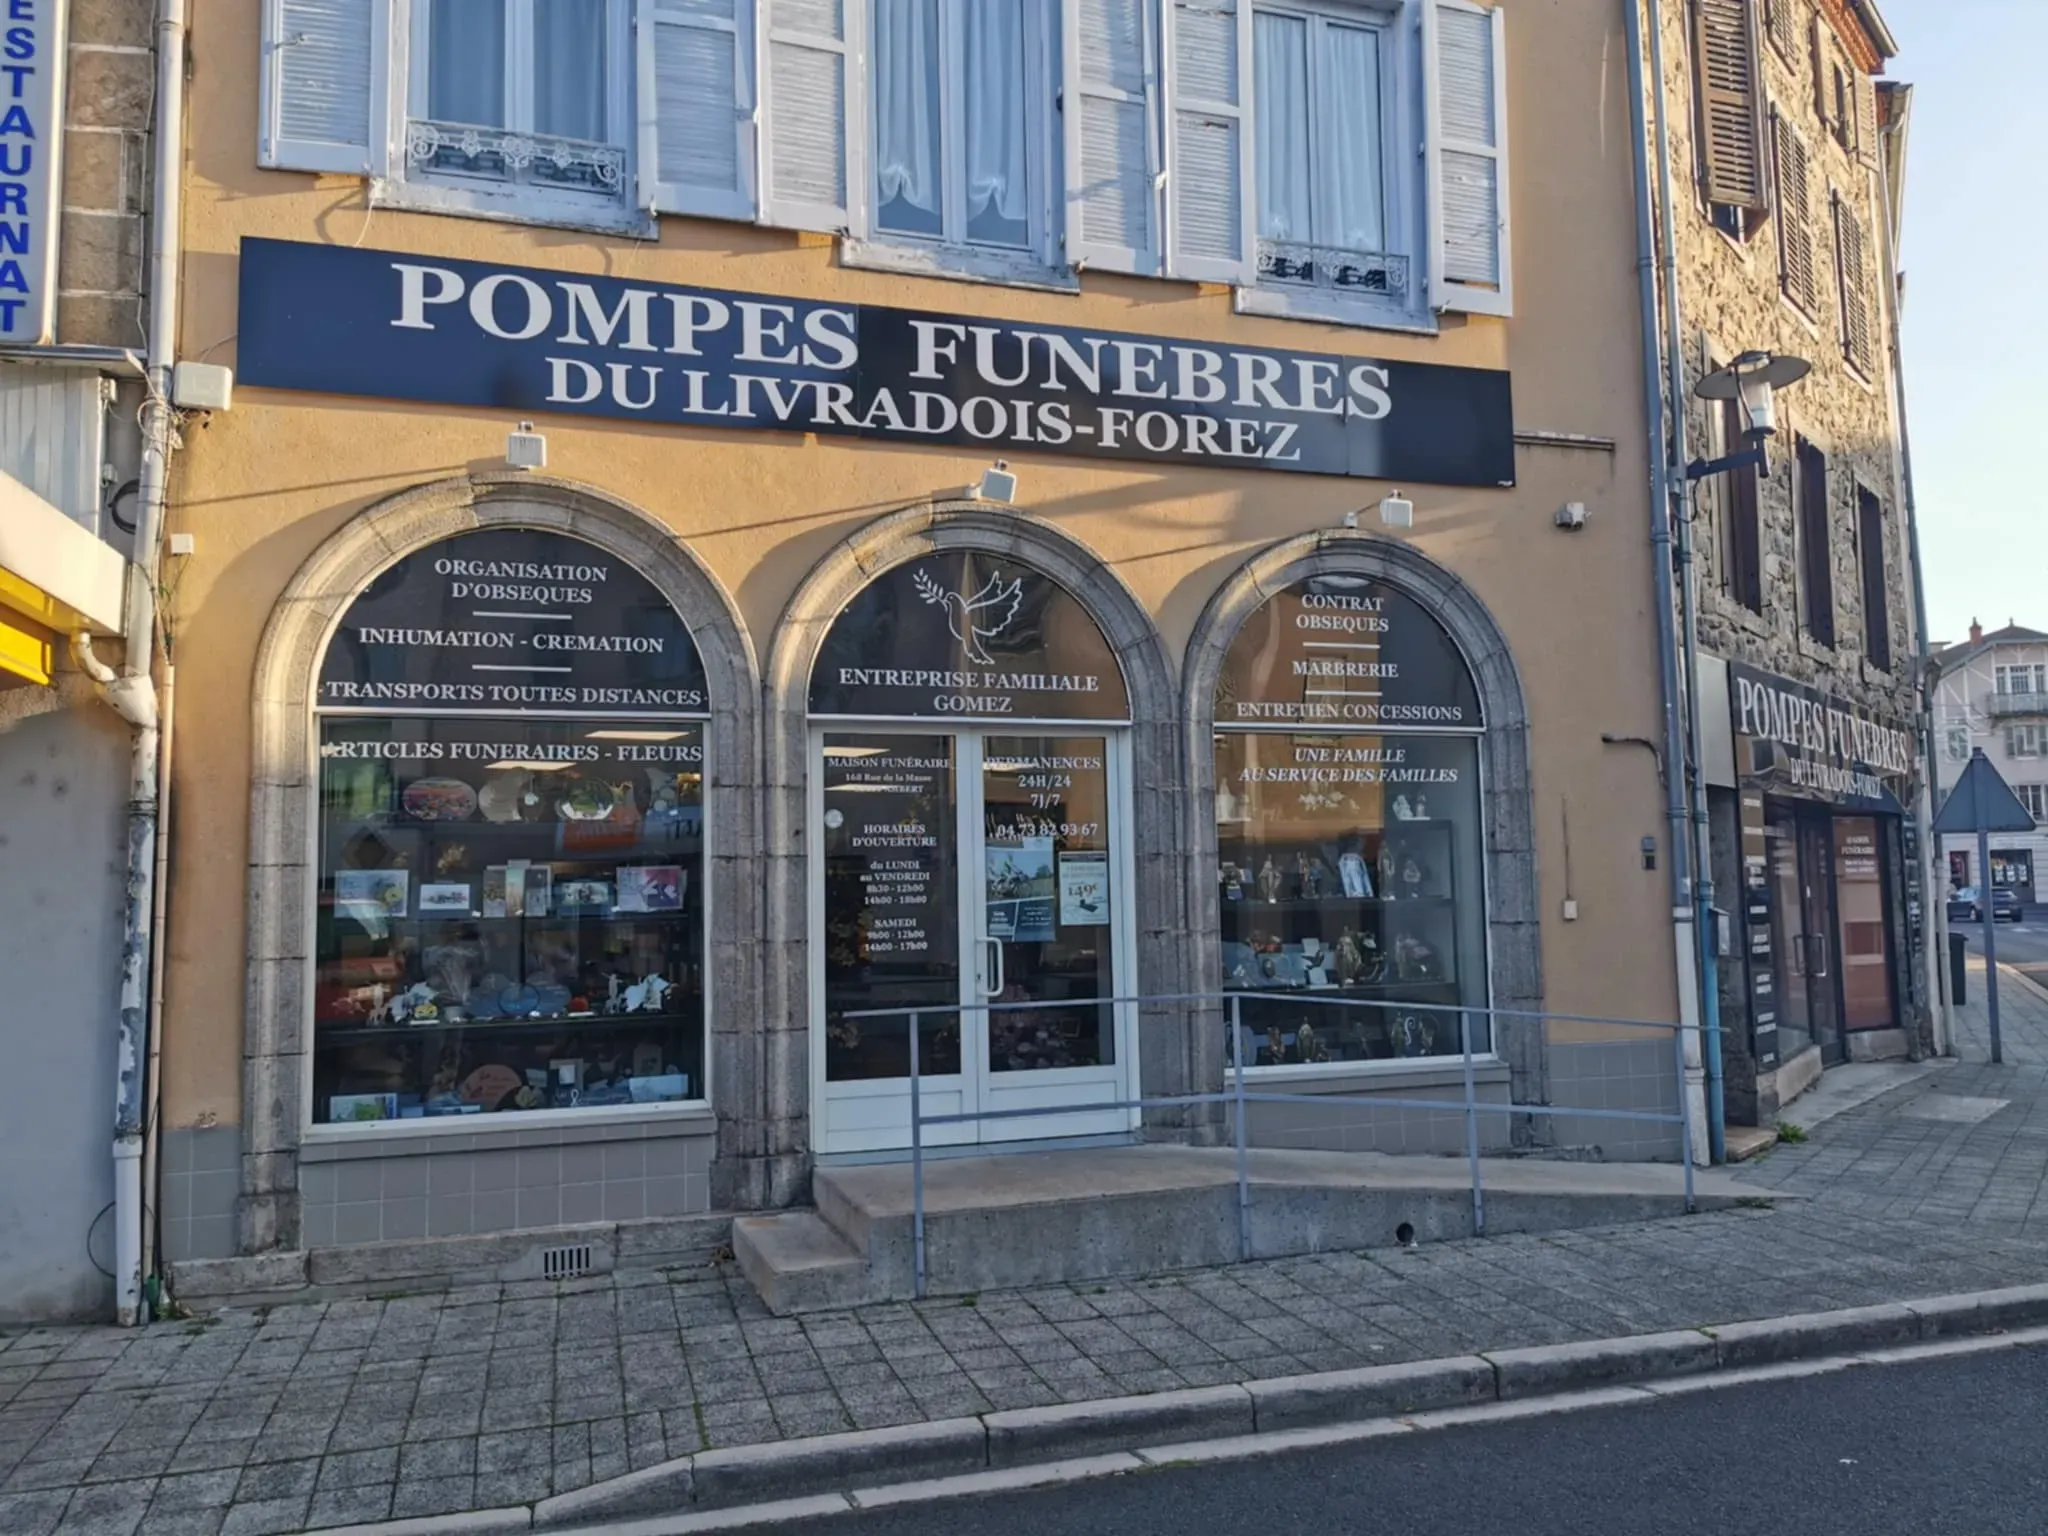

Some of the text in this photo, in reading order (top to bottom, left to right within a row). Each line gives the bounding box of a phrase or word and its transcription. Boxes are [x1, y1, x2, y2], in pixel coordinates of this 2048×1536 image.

[391, 263, 1392, 420] POMPES FUNEBRES
[545, 357, 1300, 460] DU LIVRADOIS-FOREZ
[434, 558, 608, 582] ORGANISATION
[451, 582, 593, 605] D'OBSEQUES
[1301, 594, 1384, 612] CONTRAT
[1296, 615, 1389, 633] OBSEQUES
[359, 627, 515, 648] INHUMATION
[533, 633, 664, 653] CREMATION
[1292, 660, 1399, 678] MARBRERIE
[839, 668, 1099, 692] ENTREPRISE FAMILIALE
[326, 680, 701, 705] TRANSPORTS TOUTES DISTANCES
[933, 695, 1013, 712] GOMEZ
[1236, 703, 1462, 721] ENTRETIEN CONCESSIONS
[1737, 677, 1909, 774] POMPES FUNEBRES
[321, 741, 443, 759] ARTICLES
[450, 742, 600, 761] FUNERAIRES
[617, 745, 703, 762] FLEURS
[1295, 748, 1406, 763] UNE FAMILLE
[828, 757, 878, 768] MAISON
[985, 756, 1101, 769] PERMANENCES
[1018, 774, 1071, 790] 24H/24
[1238, 768, 1458, 783] AU SERVICE DES FAMILLES
[864, 824, 925, 834] HORAIRES
[997, 823, 1098, 836] 04 73 82 93 67
[852, 836, 937, 847] D'OUVERTURE
[870, 861, 920, 870] du LUNDI
[860, 871, 930, 882] au VENDREDI
[874, 918, 917, 928] SAMEDI
